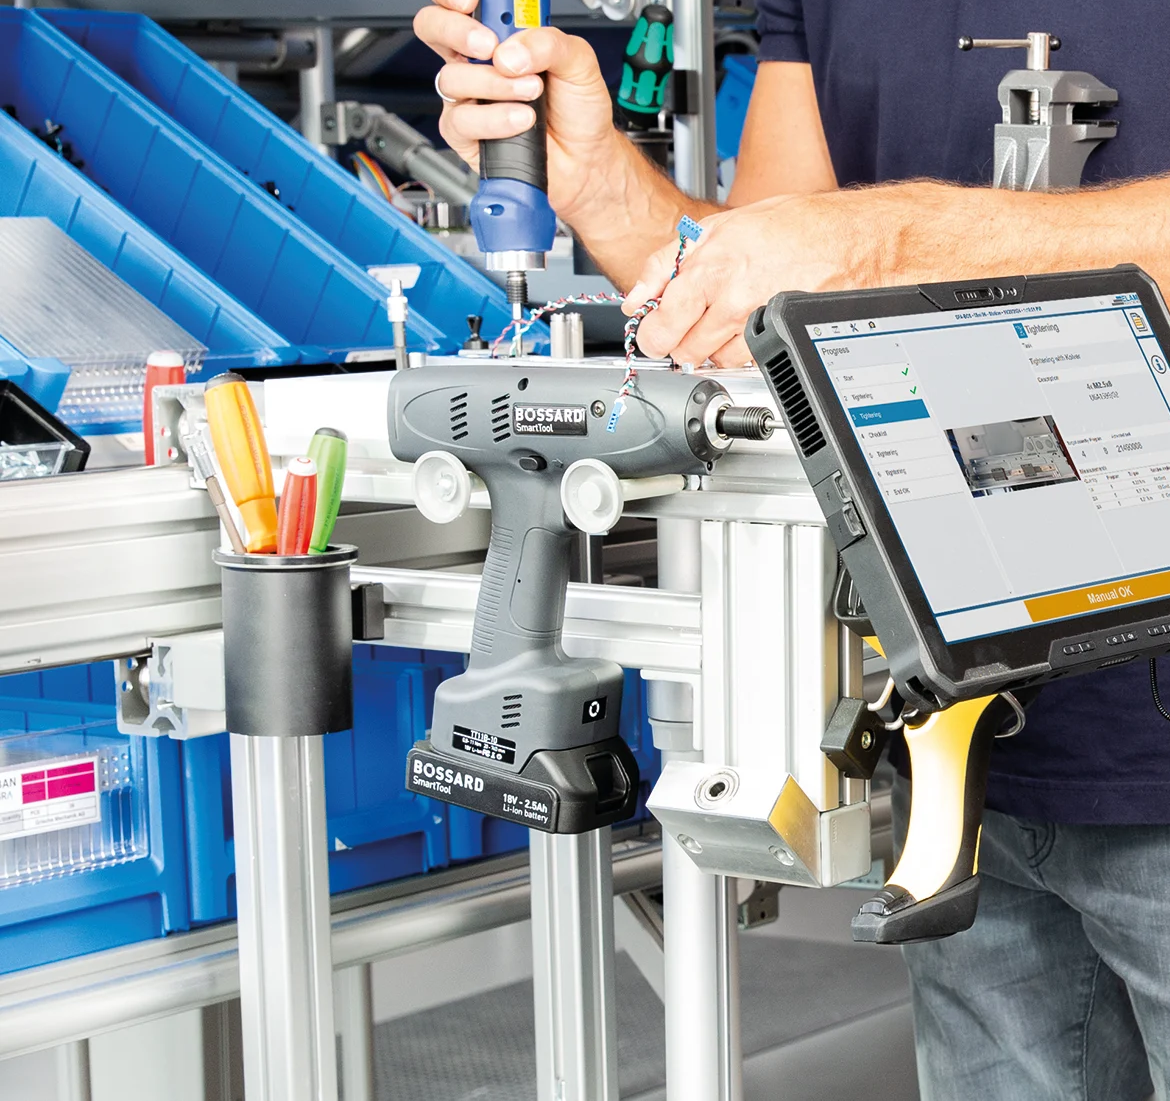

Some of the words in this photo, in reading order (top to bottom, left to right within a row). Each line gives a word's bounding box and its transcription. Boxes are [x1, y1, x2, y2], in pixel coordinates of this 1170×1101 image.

[1024, 323, 1060, 335] Tightening
[821, 346, 850, 356] Progress
[1029, 357, 1055, 366] Tightening
[852, 392, 873, 401] Tightening
[515, 407, 583, 422] BOSSARD
[860, 411, 882, 420] Tightening
[516, 423, 554, 432] SmartTool
[876, 450, 898, 458] Tightening
[885, 468, 907, 476] Tightening
[1086, 591, 1118, 604] Manual
[1118, 585, 1134, 598] OK
[414, 760, 484, 792] BOSSARD
[412, 776, 452, 794] SmartTool
[502, 793, 518, 805] 18V
[524, 800, 548, 814] 2.5Ah
[524, 810, 548, 824] battery
